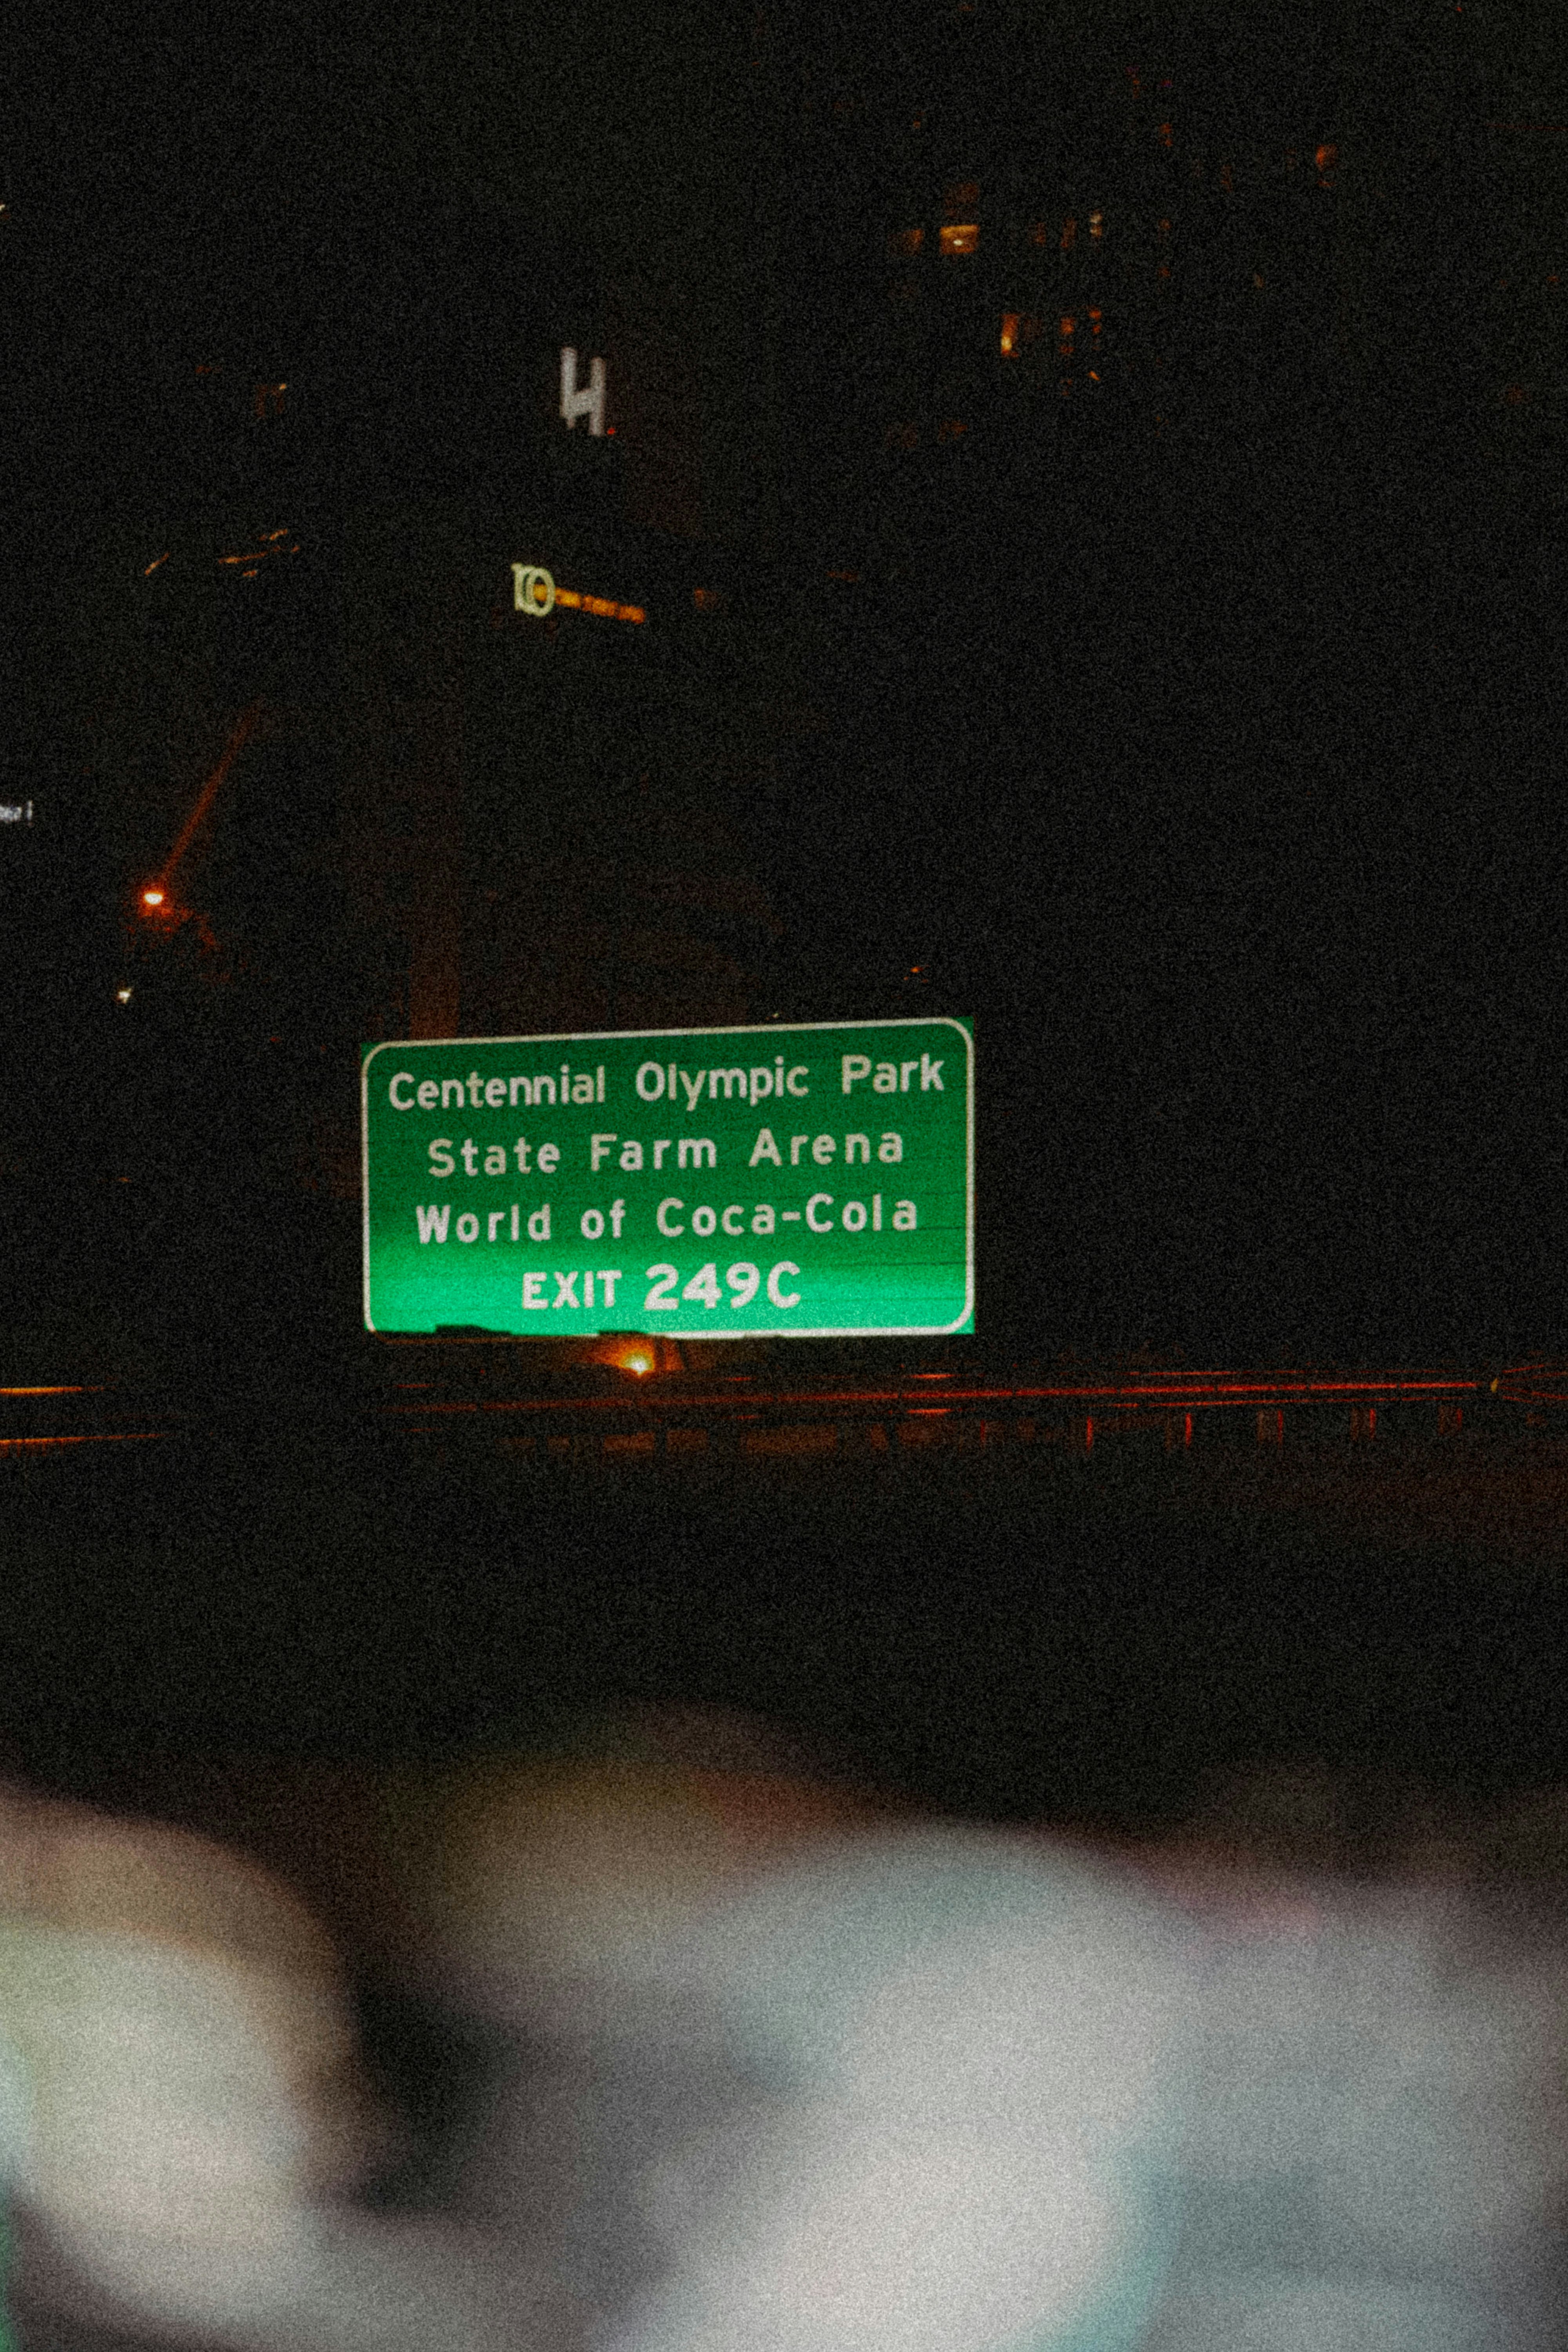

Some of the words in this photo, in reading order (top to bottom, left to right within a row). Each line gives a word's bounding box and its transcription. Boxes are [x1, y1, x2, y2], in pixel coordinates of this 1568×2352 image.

[389, 1066, 605, 1110] Centennial
[636, 1056, 809, 1111] Olympic
[842, 1054, 944, 1094] Park
[428, 1137, 561, 1177] State
[591, 1134, 717, 1171] Farm
[749, 1129, 902, 1166] Arena
[416, 1203, 551, 1244] World
[581, 1199, 625, 1240] of
[657, 1193, 916, 1237] Coca-Cola
[522, 1270, 622, 1309] EXIT
[644, 1261, 801, 1310] 249C
